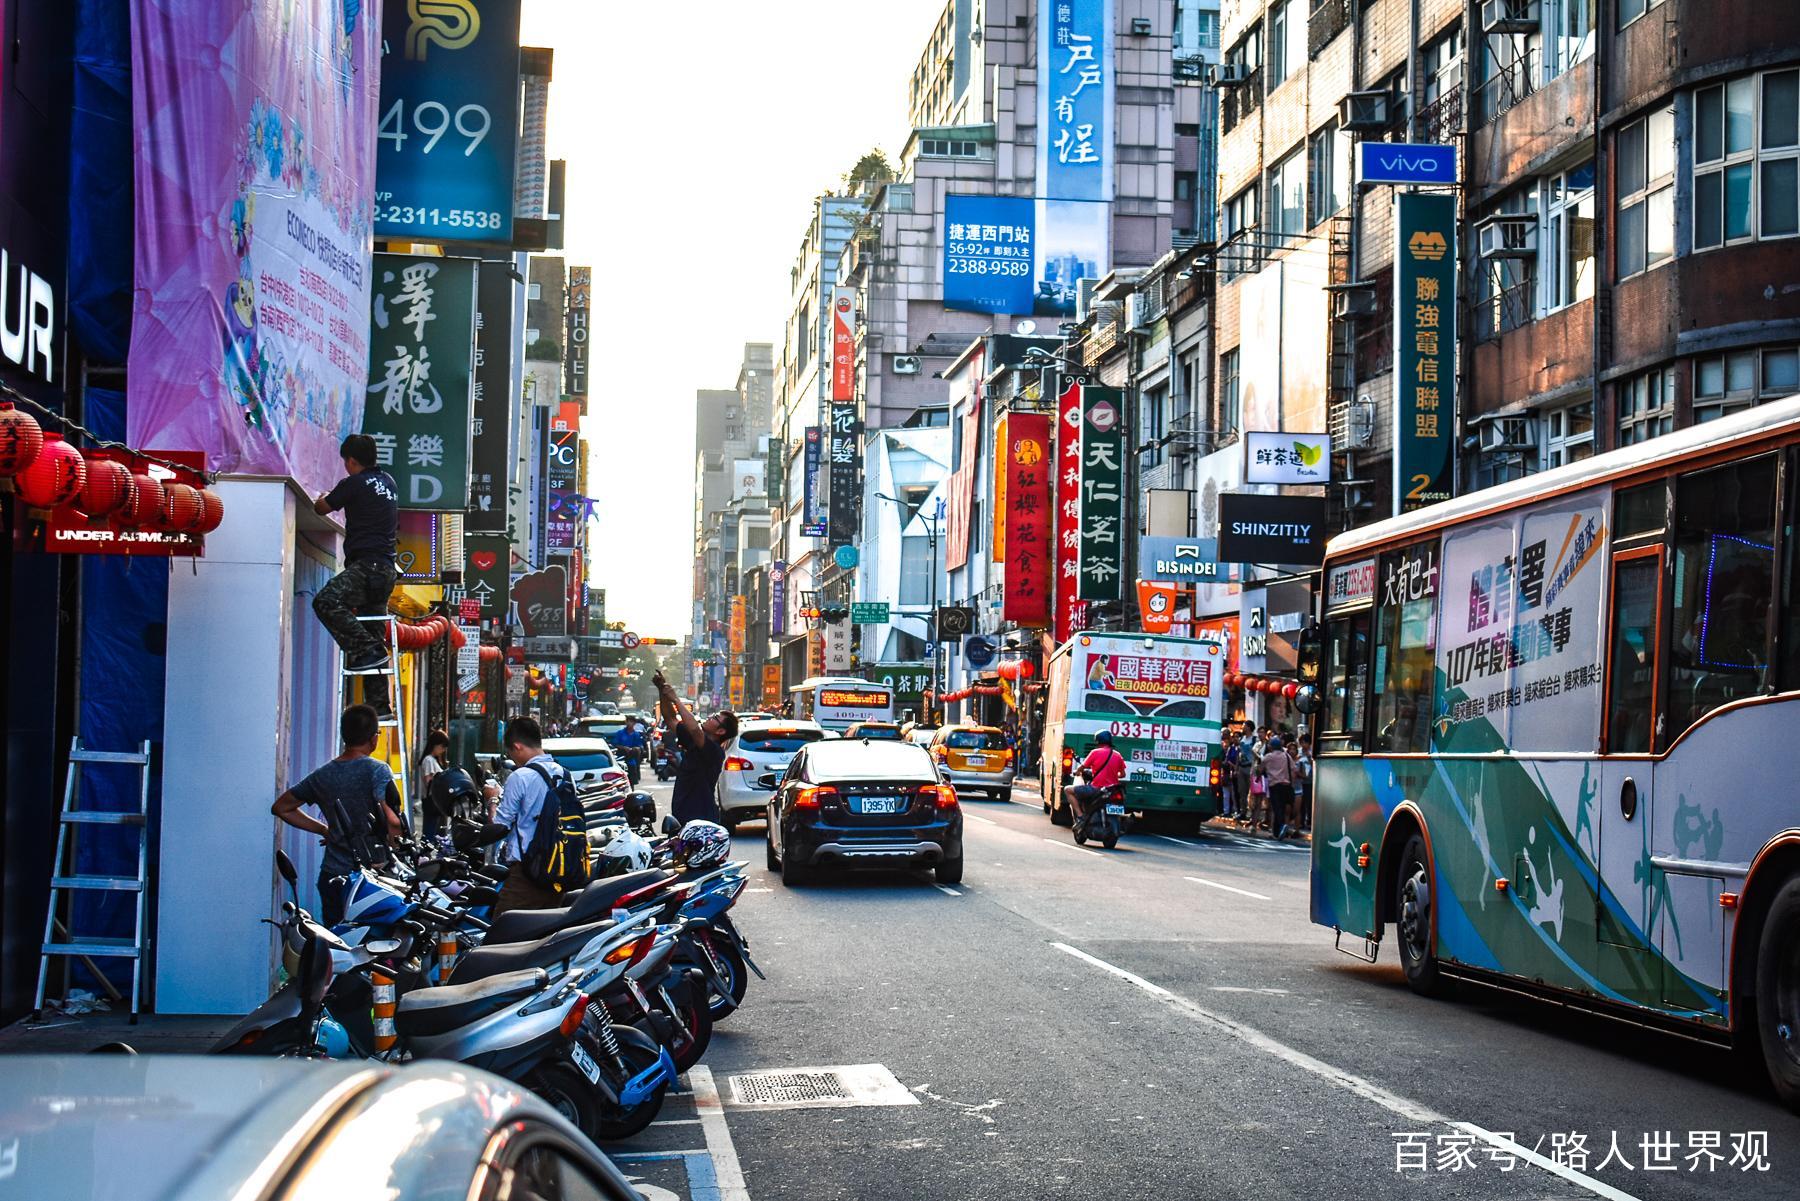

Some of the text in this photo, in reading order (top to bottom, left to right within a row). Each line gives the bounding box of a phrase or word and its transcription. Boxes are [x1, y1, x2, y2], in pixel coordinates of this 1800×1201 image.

[378, 99, 491, 157] 499
[1380, 154, 1438, 172] vivo
[949, 223, 1030, 243] 捷運西門站
[949, 259, 1030, 277] 2388-9589
[0, 249, 54, 383] UR
[572, 313, 588, 393] HOTEL
[1415, 277, 1440, 438] 聯強電信聯盟
[1255, 448, 1304, 467] 鮮茶道
[551, 480, 565, 488] 3F
[1405, 473, 1451, 501] 2 years
[1082, 441, 1120, 584] 天仁茗茶
[55, 530, 114, 541] UNDER
[549, 538, 562, 547] 2F
[1383, 551, 1438, 607] 大有巴士
[1468, 538, 1547, 634] 體育署
[528, 602, 564, 621] 988
[925, 642, 933, 654] P
[1117, 656, 1209, 685] 國華徵信
[1133, 683, 1208, 696] 0800-667-666
[1110, 721, 1172, 739] 033-FU
[1132, 750, 1152, 761] 513
